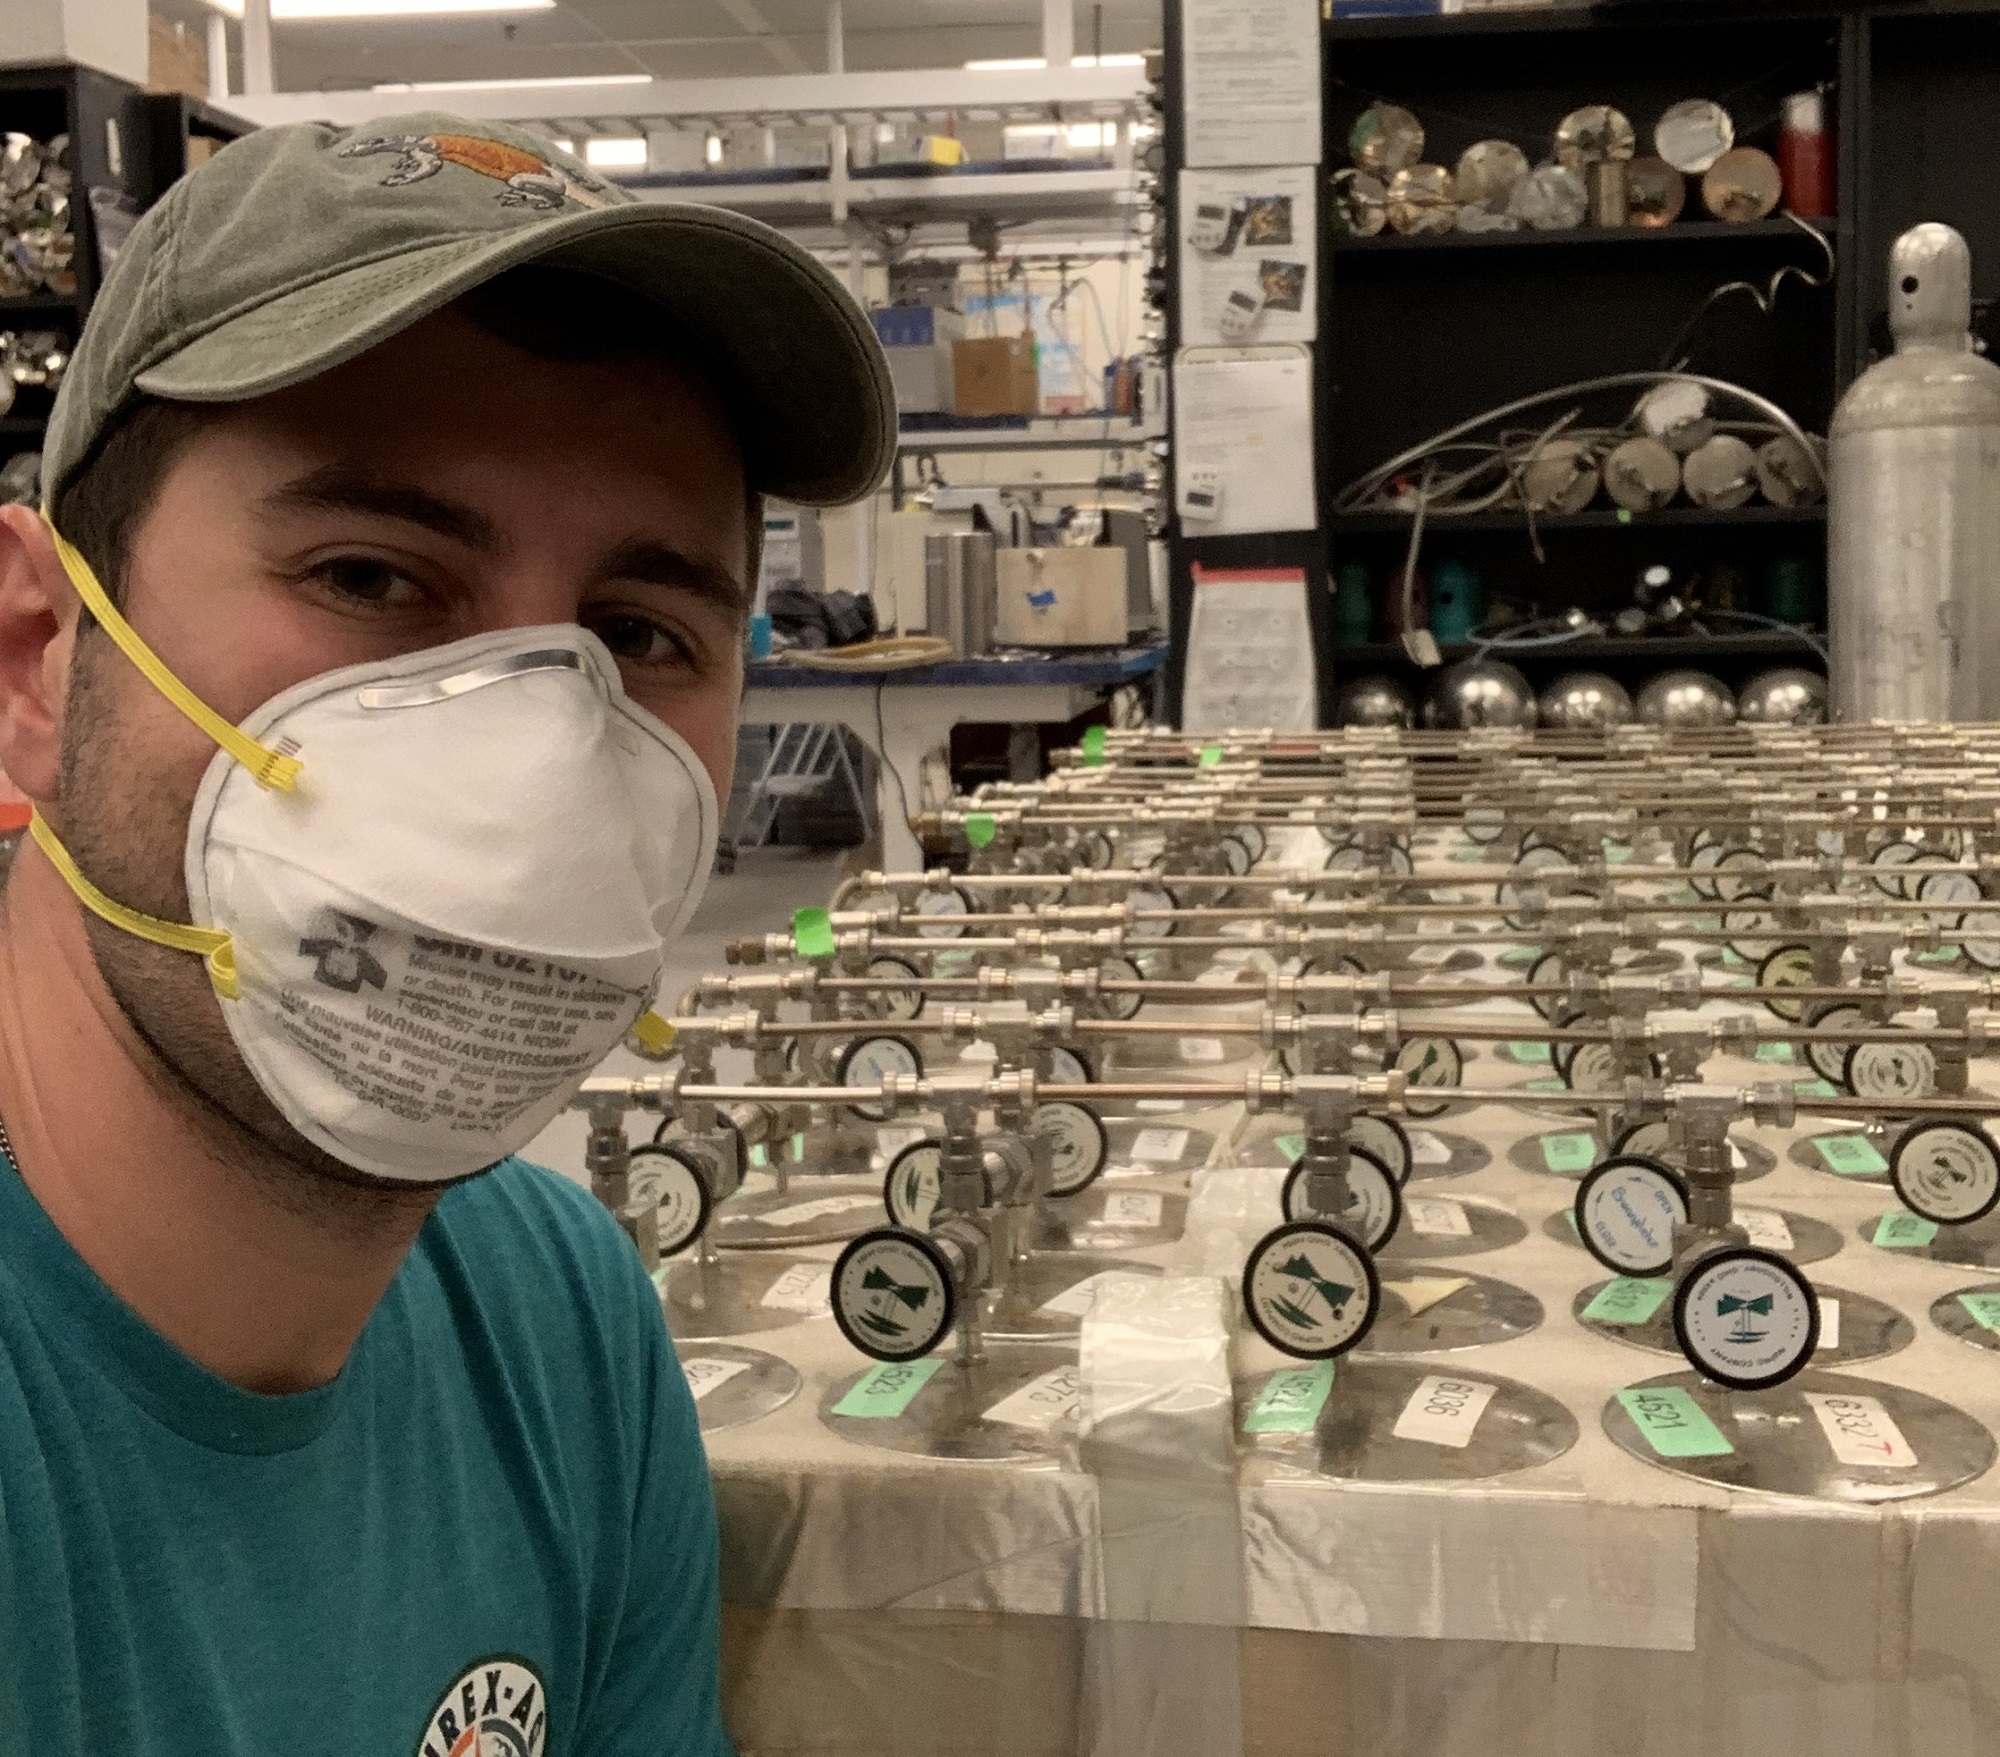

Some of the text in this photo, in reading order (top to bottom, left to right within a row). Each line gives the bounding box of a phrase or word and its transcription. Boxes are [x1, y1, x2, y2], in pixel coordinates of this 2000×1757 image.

[1654, 1189, 1674, 1215] OPEN
[1709, 1346, 1755, 1368] COMPANY
[1423, 1381, 1475, 1417] 6036
[1632, 1394, 1689, 1430] 4521
